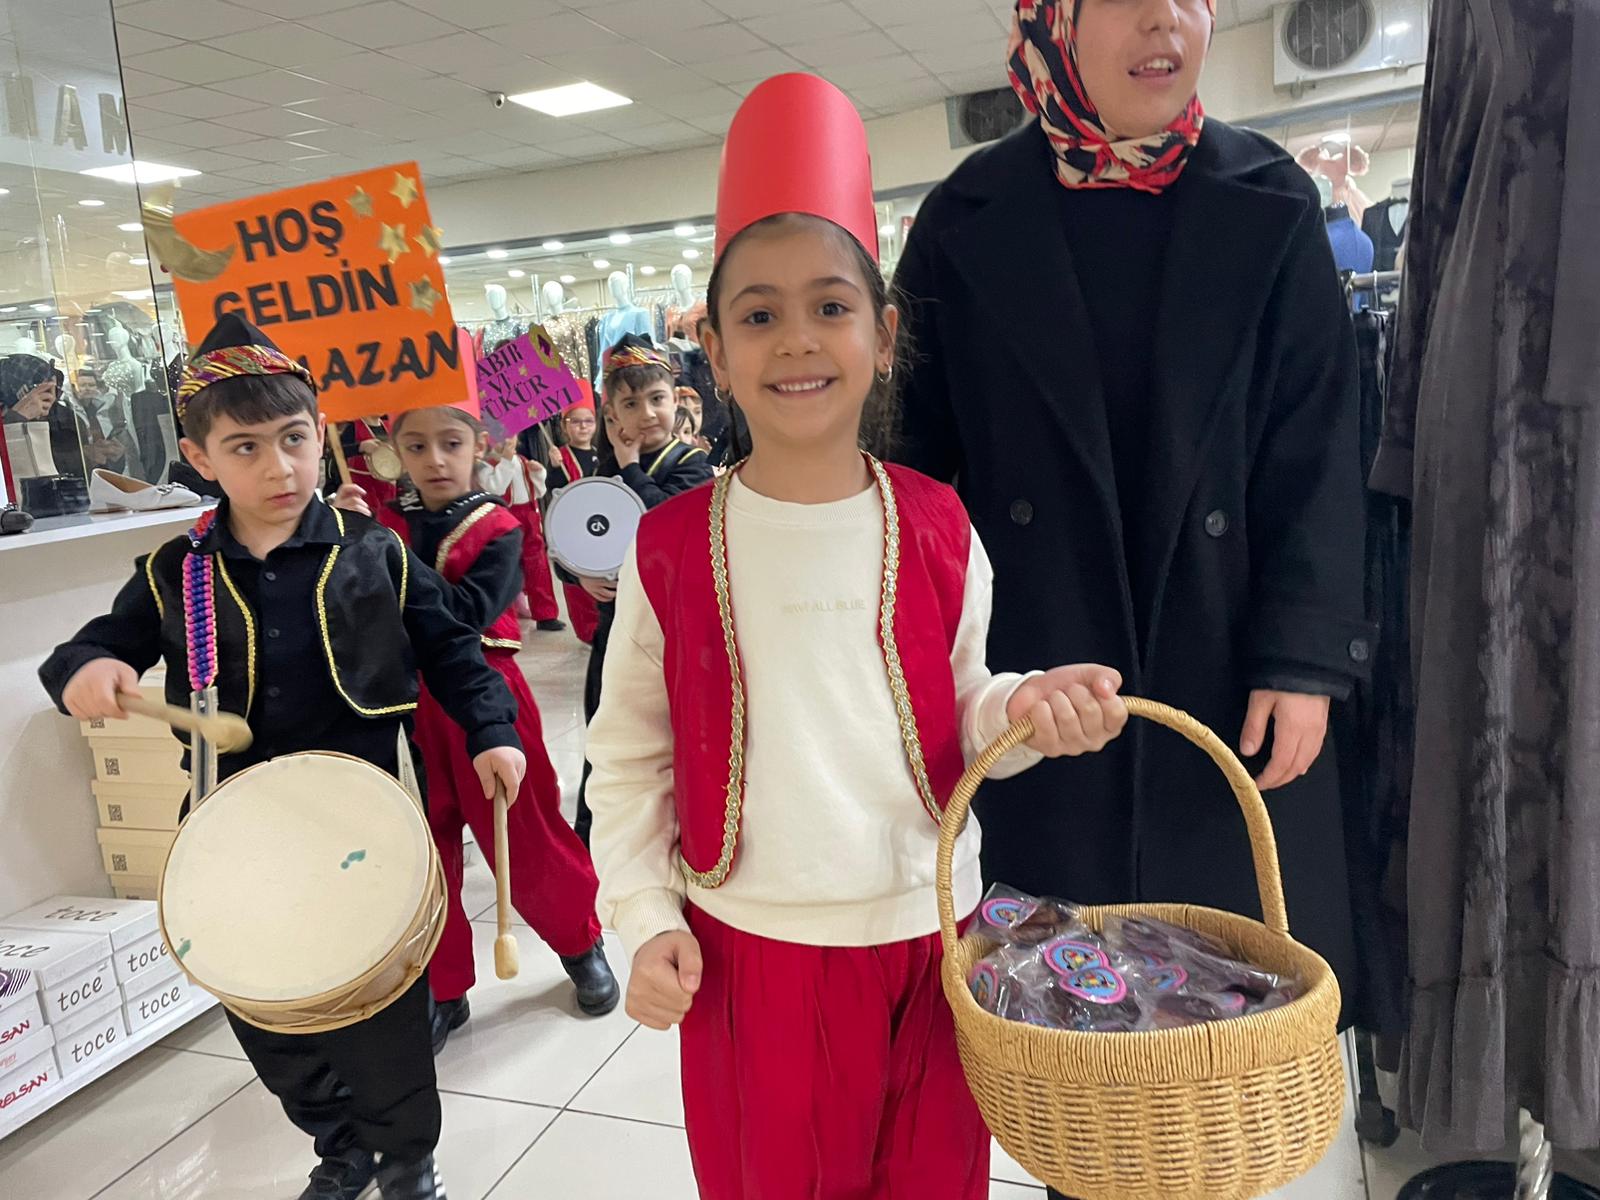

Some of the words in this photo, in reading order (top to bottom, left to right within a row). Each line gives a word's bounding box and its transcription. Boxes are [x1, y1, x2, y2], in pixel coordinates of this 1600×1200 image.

[235, 200, 343, 262] HOŞ
[213, 259, 400, 326] GELDİN
[298, 326, 459, 392] AZAN
[476, 343, 523, 377] ABIR
[481, 375, 549, 420] ÜKÜR
[44, 905, 118, 922] toce
[57, 976, 104, 1012] toce
[139, 986, 181, 1020] toce
[0, 1019, 30, 1044] SAN
[71, 1026, 117, 1064] toce
